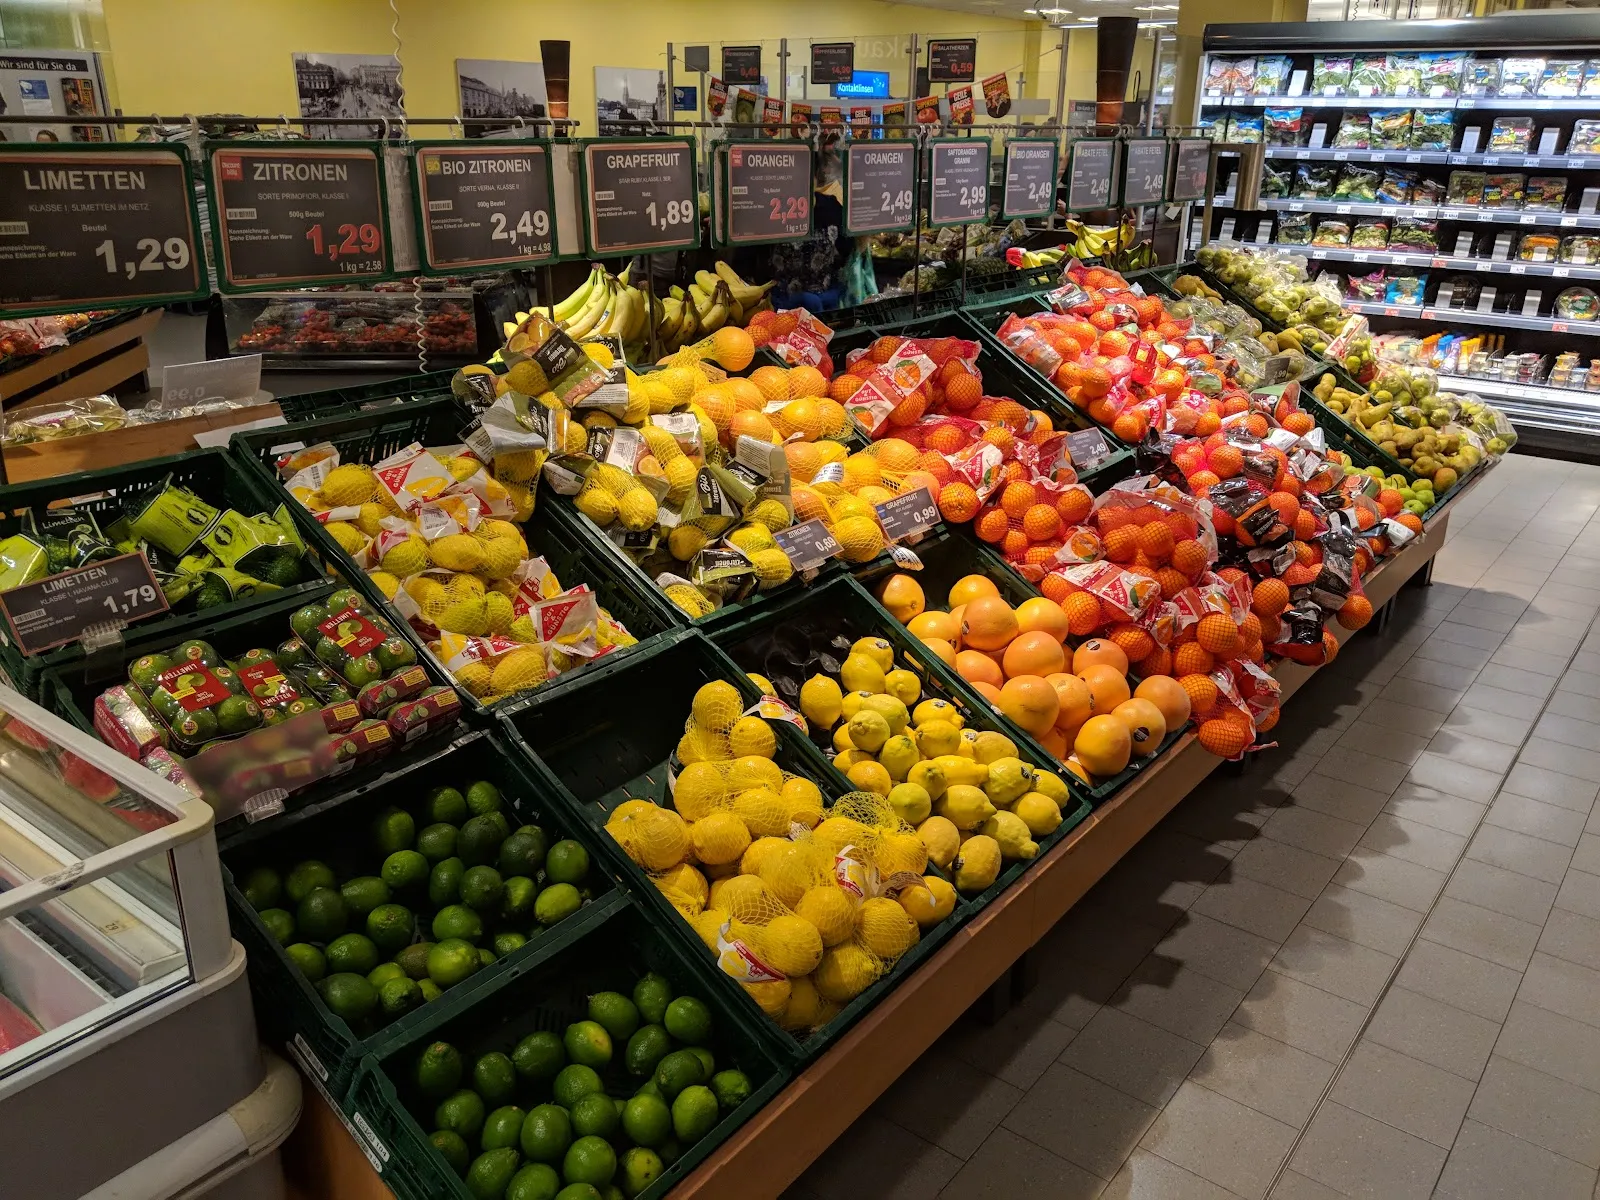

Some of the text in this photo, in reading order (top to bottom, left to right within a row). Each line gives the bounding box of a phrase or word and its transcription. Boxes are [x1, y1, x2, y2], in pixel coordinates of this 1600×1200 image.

[0, 60, 77, 71] Wir sind für Sie da
[950, 62, 973, 76] 0,59
[837, 83, 874, 94] Kontaktlinsen
[606, 153, 681, 169] GRAPEFRUIT
[748, 155, 795, 167] ORANGEN
[864, 152, 904, 165] ORANGEN
[253, 163, 349, 181] ZITRONEN
[442, 159, 531, 175] BIO ZITRONEN
[23, 170, 146, 191] LIMETTEN
[1090, 179, 1110, 197] 2,49
[1143, 174, 1163, 193] 2,49
[321, 192, 345, 200] KLASSE
[959, 186, 986, 209] 2,99
[1028, 182, 1052, 202] 2,49
[28, 204, 63, 212] KLASSE
[118, 203, 128, 211] IM
[128, 202, 149, 211] NETZ
[769, 197, 809, 224] 2,29
[880, 190, 913, 216] 2,49
[289, 210, 325, 219] 500g Beutel
[645, 199, 694, 232] 1,89
[81, 224, 107, 232] Beutel
[490, 210, 550, 246] 2,49
[0, 244, 47, 252] ennzeichnung:
[306, 223, 381, 262] 1,29
[523, 245, 532, 255] kg
[95, 237, 190, 281] 1,29
[340, 262, 344, 272] 1
[346, 262, 357, 274] kg
[366, 260, 382, 271] 2,58
[1089, 442, 1106, 455] 2,49
[885, 493, 919, 510] GRAPEFRUIT
[913, 505, 936, 523] 0,99
[814, 536, 837, 552] 0,69
[42, 566, 108, 594] LIMETTEN
[40, 592, 68, 606] KLASSE
[101, 577, 119, 588] CLUB
[103, 585, 157, 614] 1,79
[543, 608, 556, 622] GUT
